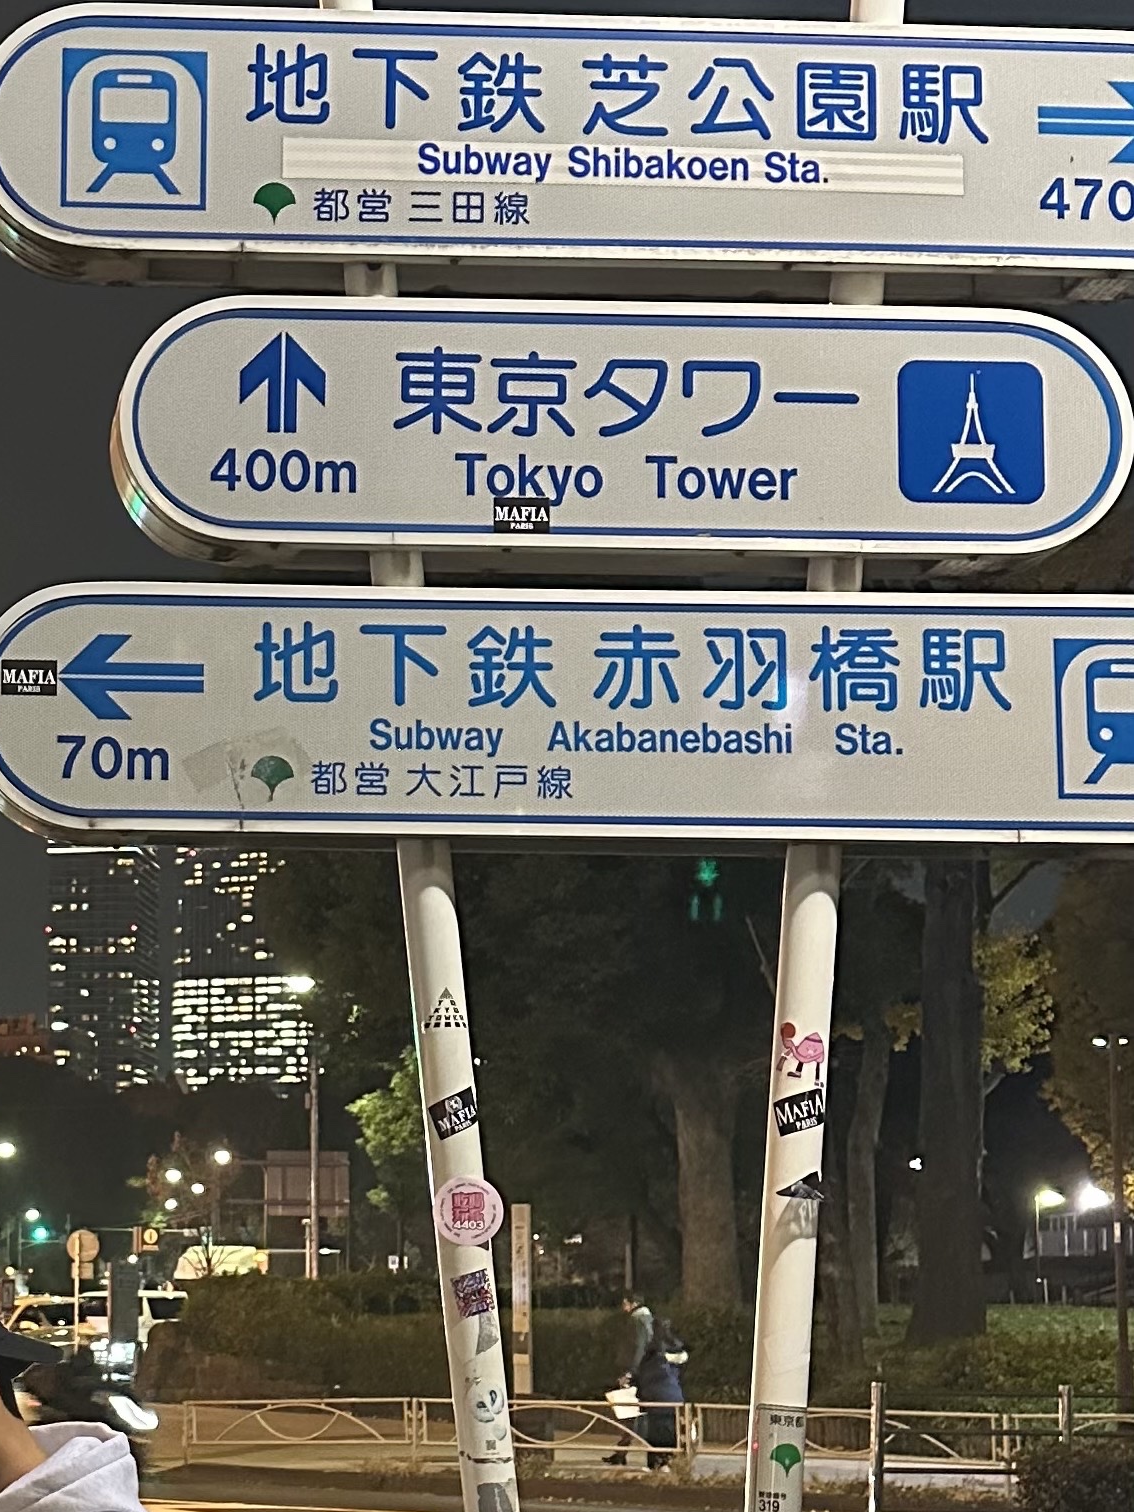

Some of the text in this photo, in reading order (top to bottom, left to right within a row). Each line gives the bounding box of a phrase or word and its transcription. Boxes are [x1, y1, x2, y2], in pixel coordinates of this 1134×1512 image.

[417, 142, 830, 185] Subway Shibakoen Sta.
[392, 345, 861, 438] 東京タワー
[209, 447, 358, 494] 400m
[454, 452, 799, 507] Tokyo Tower
[494, 505, 549, 522] MAFIA
[2, 668, 56, 685] MAFIA
[369, 718, 904, 758] Subway Akabanebashi Sta.
[56, 735, 170, 782] 70m
[437, 1104, 477, 1132] MAFIA
[775, 1093, 825, 1127] MAFIA
[453, 1219, 485, 1231] 4403
[758, 1498, 780, 1512] 319
